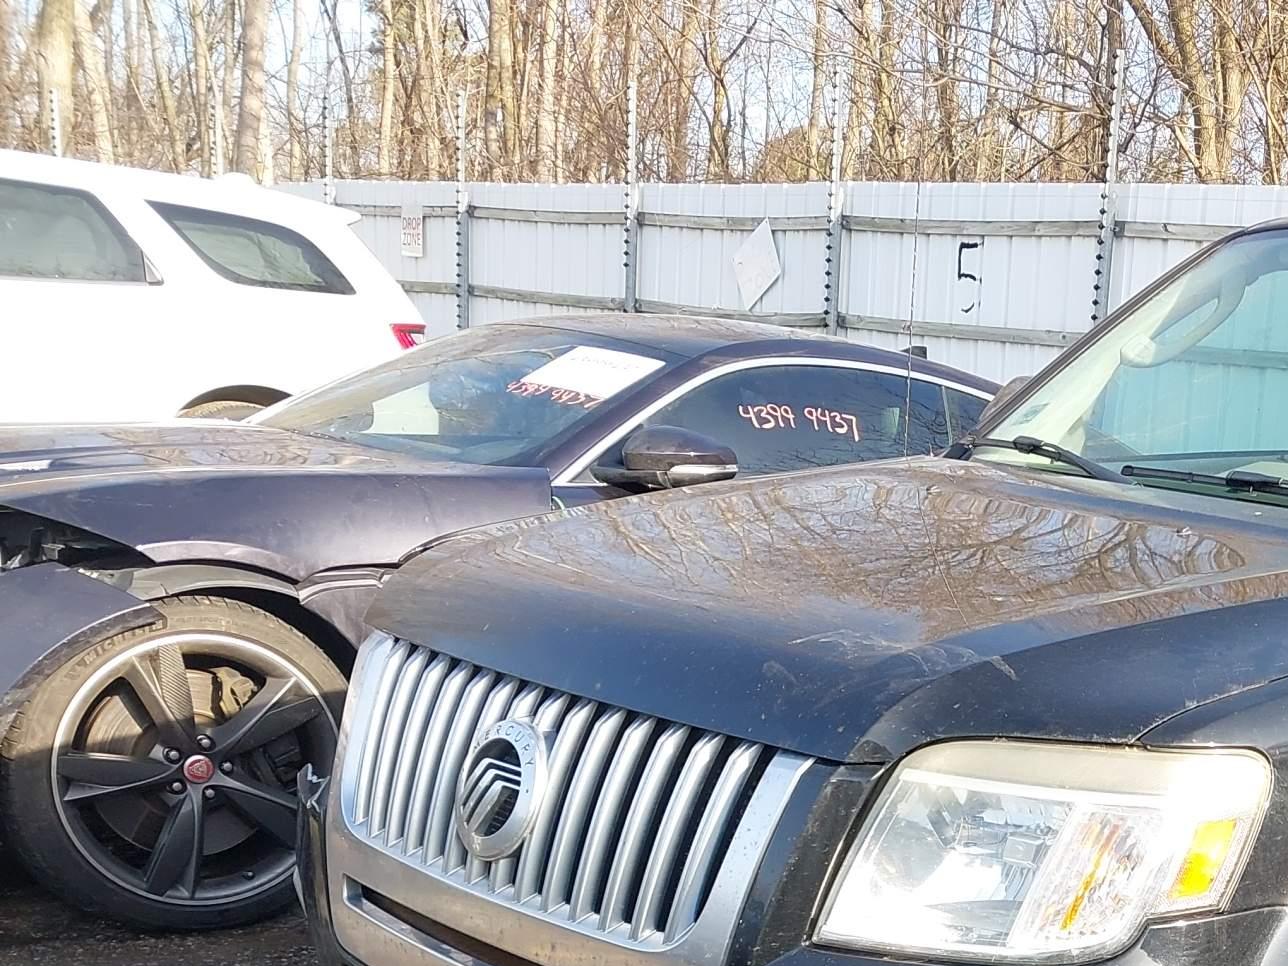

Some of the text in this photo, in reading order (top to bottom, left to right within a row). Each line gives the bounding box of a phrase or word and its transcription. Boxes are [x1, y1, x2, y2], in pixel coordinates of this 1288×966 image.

[402, 216, 422, 231] DROP
[402, 231, 422, 247] ZONE
[957, 241, 983, 314] 5
[738, 403, 860, 442] 4399 9437
[472, 724, 536, 768] MERCURY
